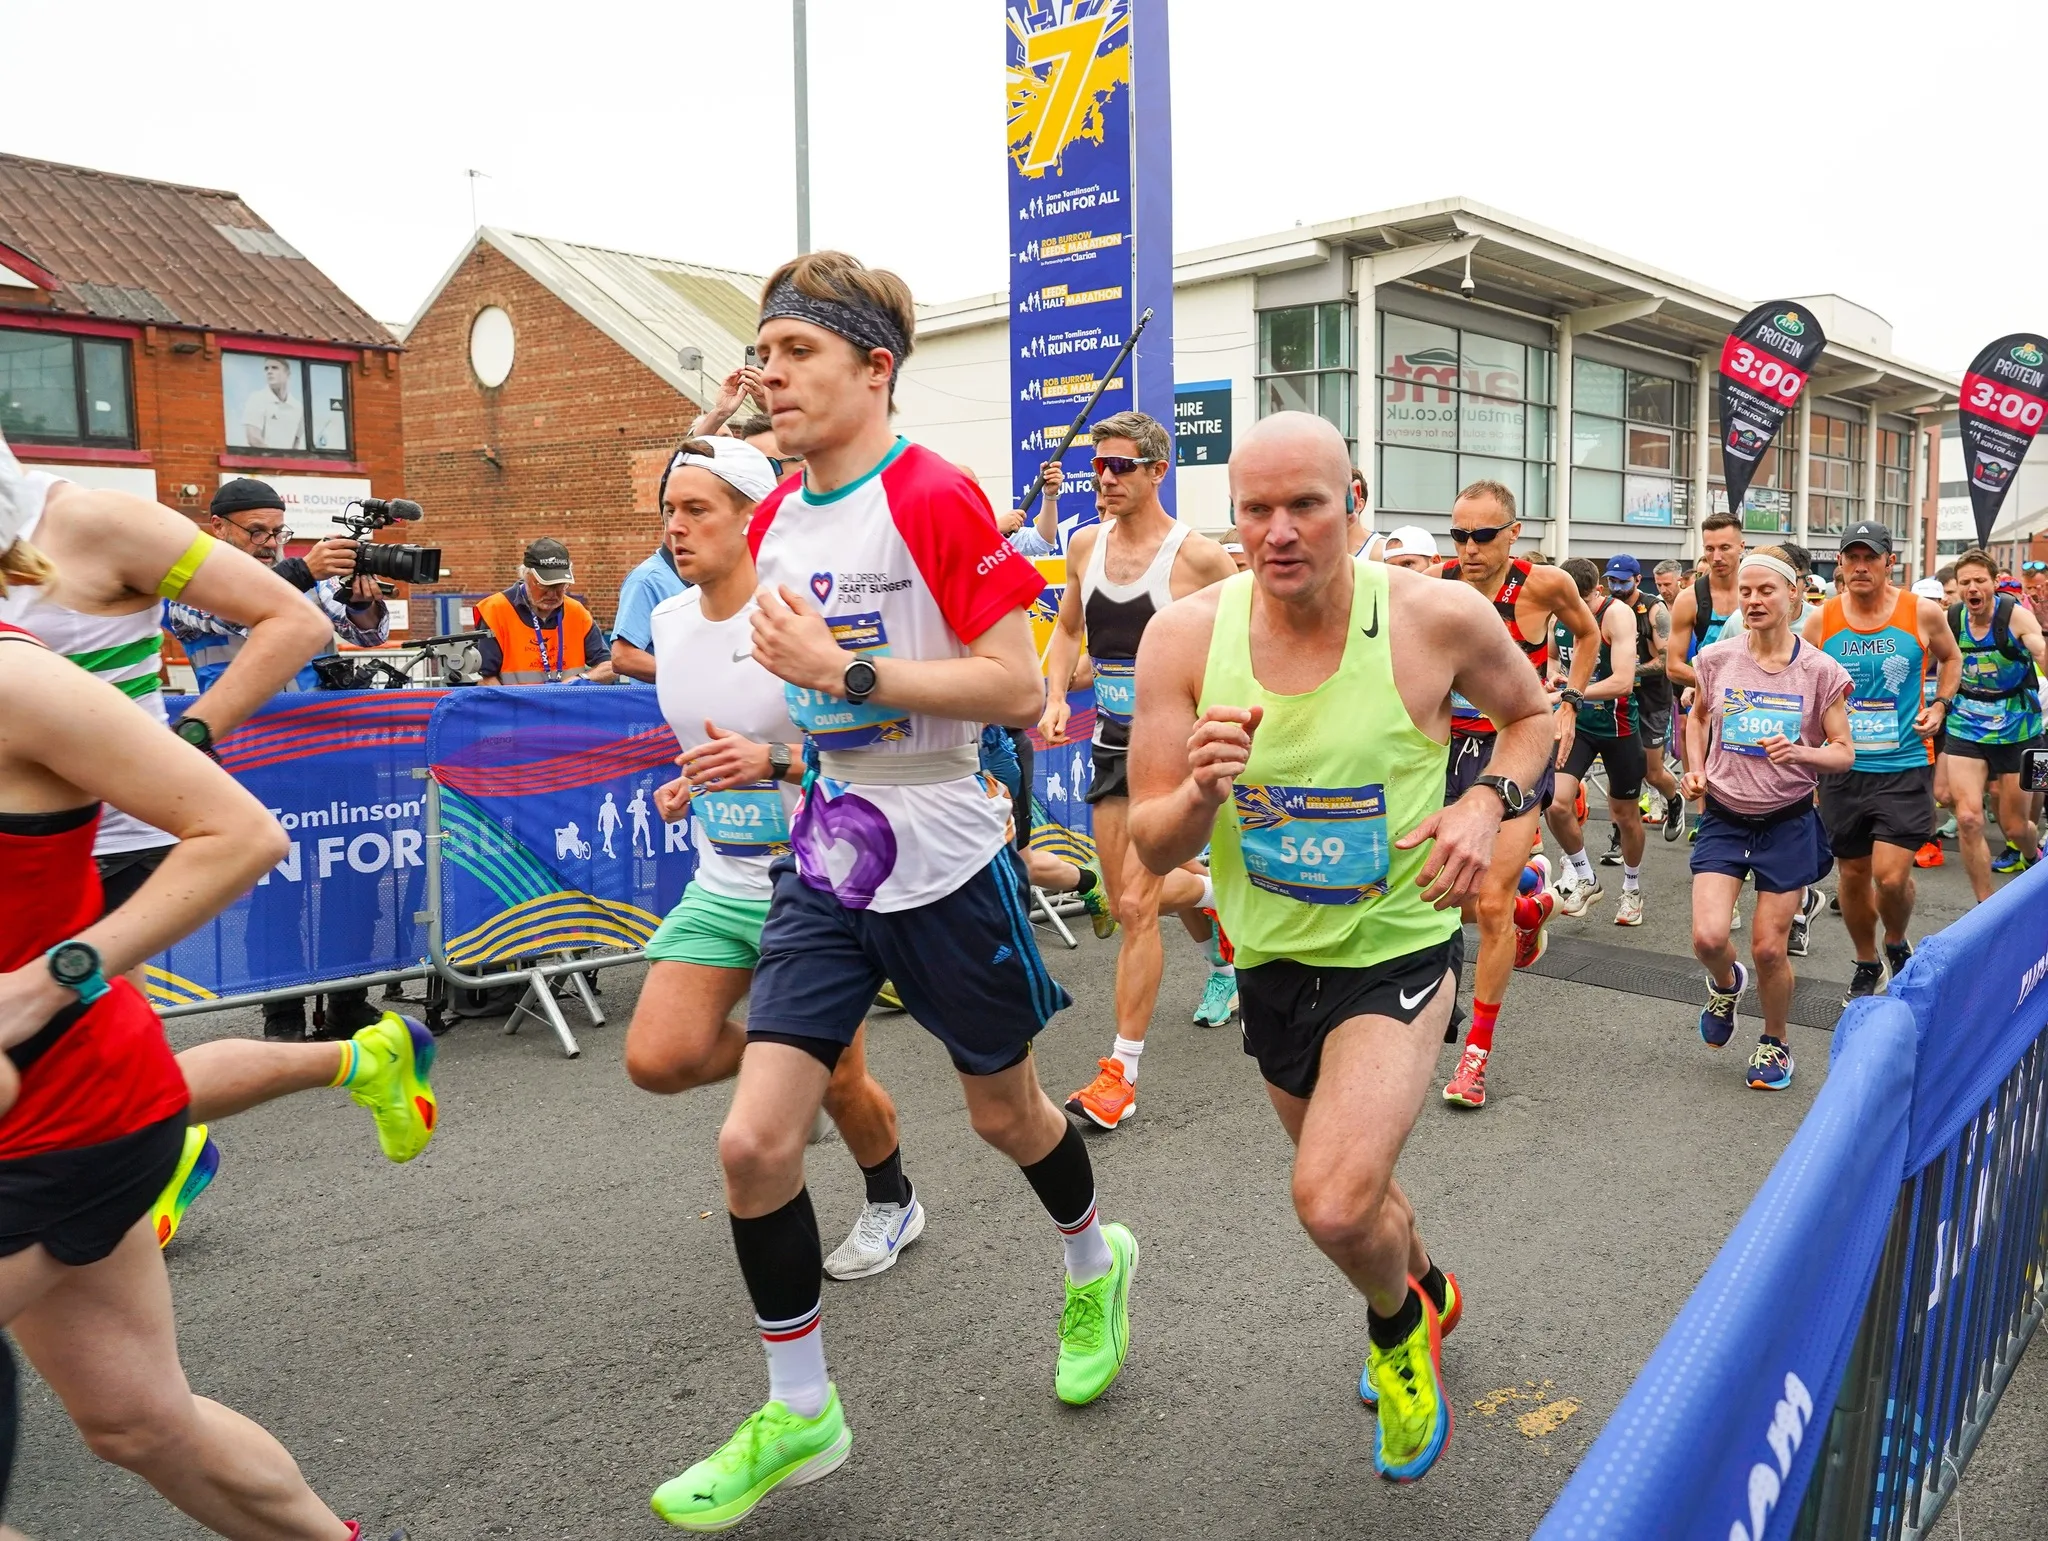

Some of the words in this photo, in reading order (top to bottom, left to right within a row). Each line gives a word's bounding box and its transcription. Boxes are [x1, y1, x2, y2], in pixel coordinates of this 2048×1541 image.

[1046, 193, 1062, 202] Jane
[1063, 184, 1100, 198] Tomlinson's
[1046, 200, 1070, 216] RUN
[1073, 196, 1096, 212] FOR
[1098, 190, 1120, 205] ALL
[1041, 236, 1057, 247] ROB
[1058, 231, 1092, 244] BURROW
[1041, 243, 1066, 258] LEEDS
[1068, 234, 1121, 253] MARATHON
[1071, 251, 1097, 262] Clarion
[1042, 285, 1068, 299] LEEDS
[1042, 297, 1065, 310] HALF
[1066, 288, 1121, 306] MARATHON
[1779, 317, 1799, 331] Arla
[1048, 334, 1063, 342] Jane
[1065, 327, 1101, 338] Tomlinson's
[1756, 325, 1804, 359] PROTEIN
[1048, 341, 1072, 356] RUN
[1075, 338, 1097, 352] FOR
[1100, 334, 1122, 348] ALL
[2016, 349, 2037, 361] Arla
[1043, 377, 1058, 386] ROB
[1060, 373, 1094, 385] BURROW
[1730, 347, 1801, 397] 3:00
[1994, 358, 2044, 388] PROTEIN
[1043, 384, 1068, 396] LEEDS
[1070, 379, 1122, 395] MARAON
[1174, 401, 1204, 417] HIRE
[1728, 385, 1785, 417] #FEEDYOURDRIVE
[1970, 382, 2045, 427] 3:00
[1737, 407, 1750, 417] RUN
[1749, 412, 1762, 423] FOR
[1762, 419, 1773, 428] ALL
[1969, 420, 2029, 446] #FEEDYOURDRIVE
[1980, 440, 1994, 450] RUN
[1993, 444, 2006, 454] FOR
[2006, 450, 2017, 458] ALL
[838, 583, 866, 593] HEART
[869, 579, 913, 594] SURGERY
[839, 572, 888, 583] CHILDREN'S
[838, 594, 861, 604] FUND
[1840, 638, 1896, 656] JAMES
[814, 712, 856, 726] OLIVER
[1738, 716, 1784, 735] 3804
[1332, 797, 1379, 809] MARATHON
[1356, 807, 1379, 815] Clarion
[704, 801, 763, 827] 1202
[717, 829, 754, 840] CHARLIE
[318, 828, 425, 879] FOR
[1279, 836, 1346, 866] 569
[1300, 871, 1329, 883] PHIL
